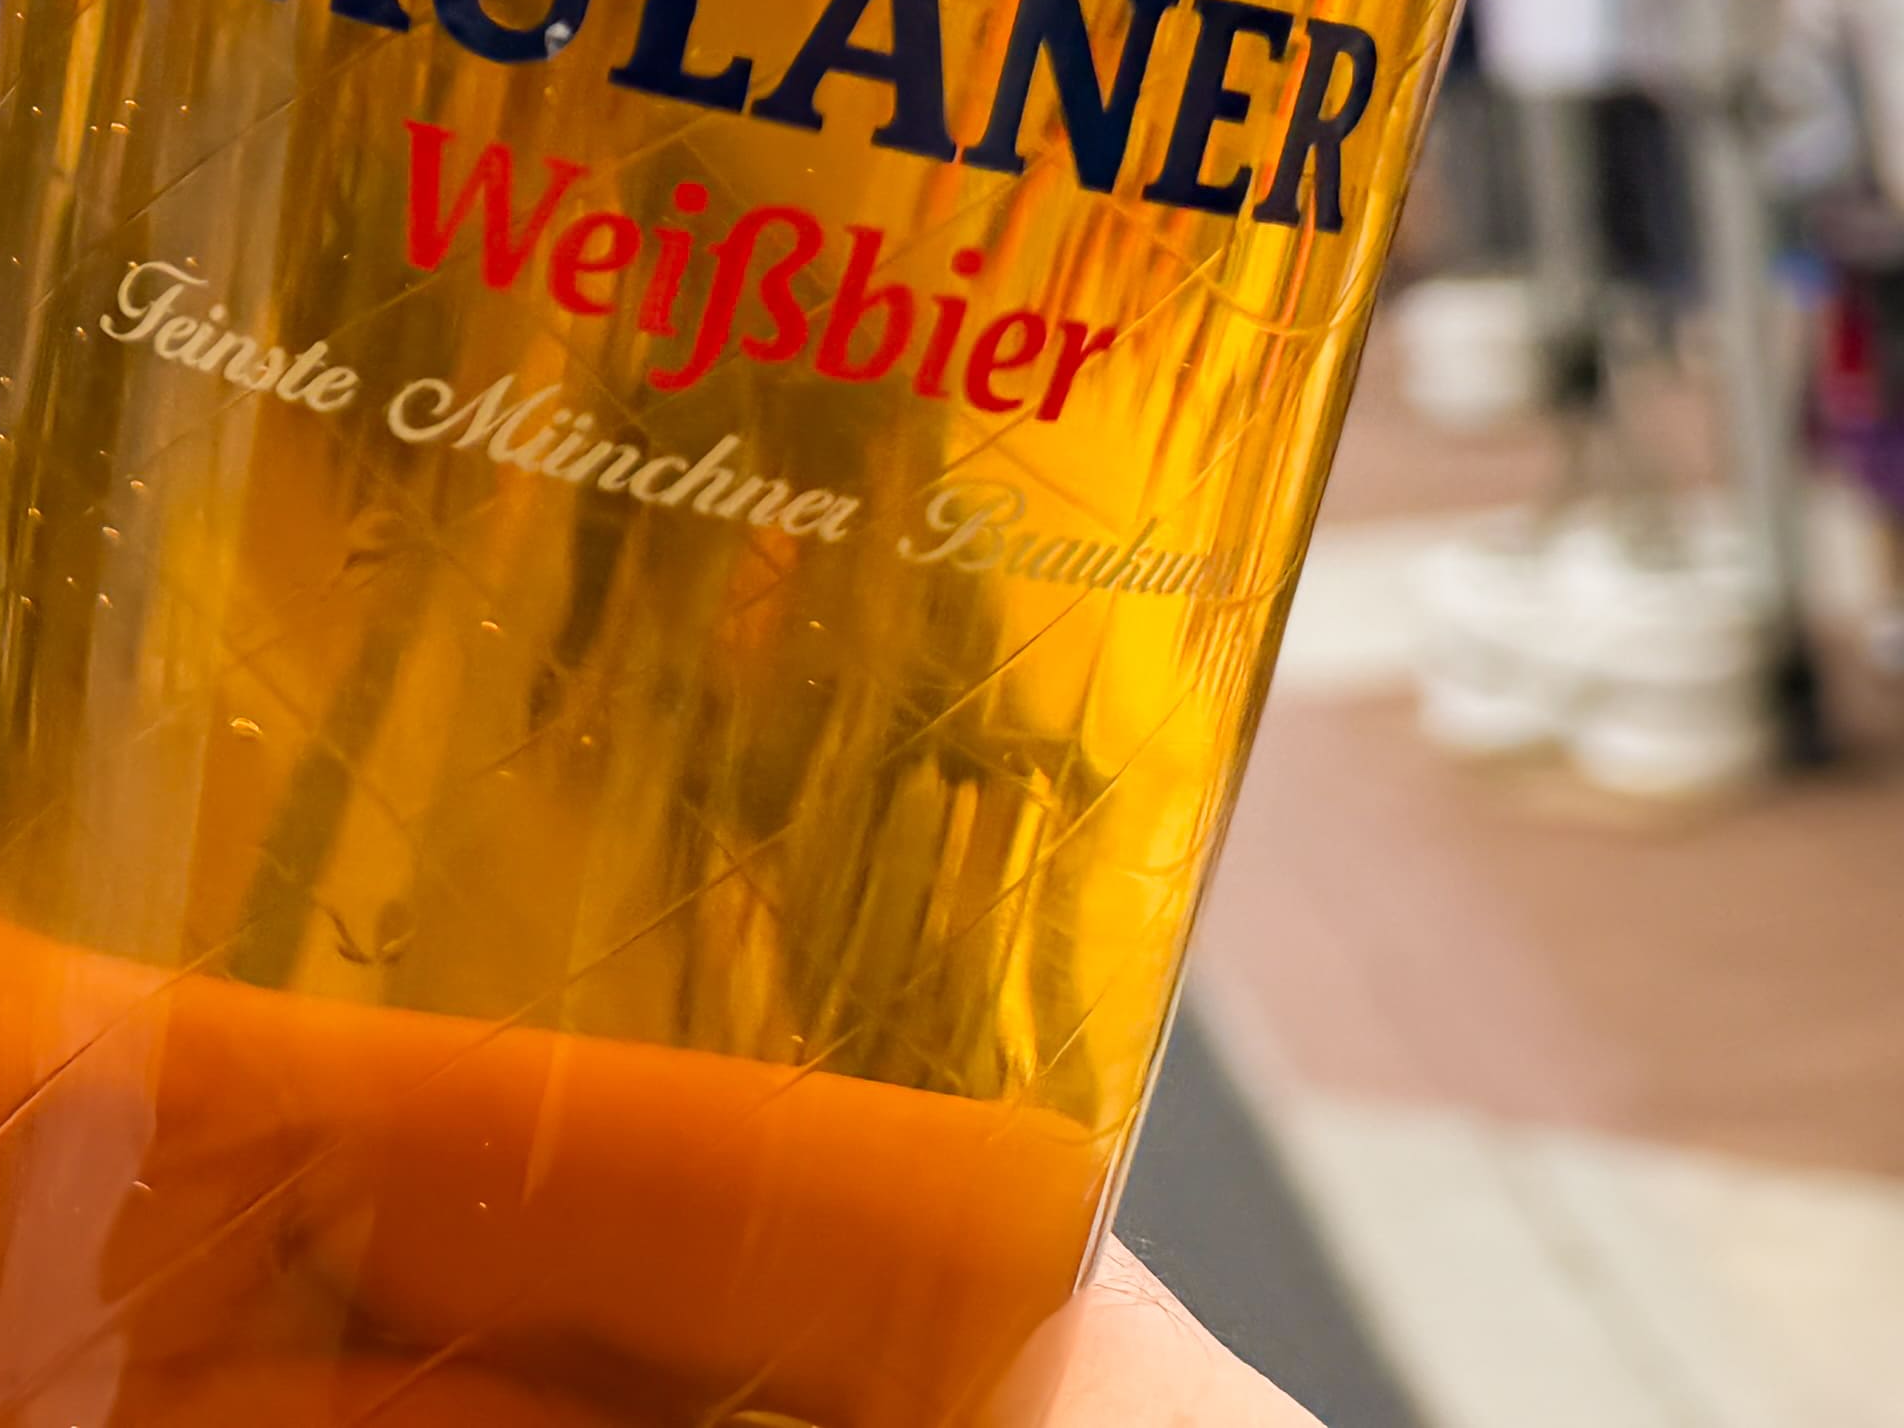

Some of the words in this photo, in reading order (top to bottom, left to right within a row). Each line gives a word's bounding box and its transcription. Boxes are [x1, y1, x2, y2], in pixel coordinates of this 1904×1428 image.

[99, 260, 362, 414] Feinste
[386, 373, 863, 544] Münchner
[402, 117, 1120, 423] Weißbier
